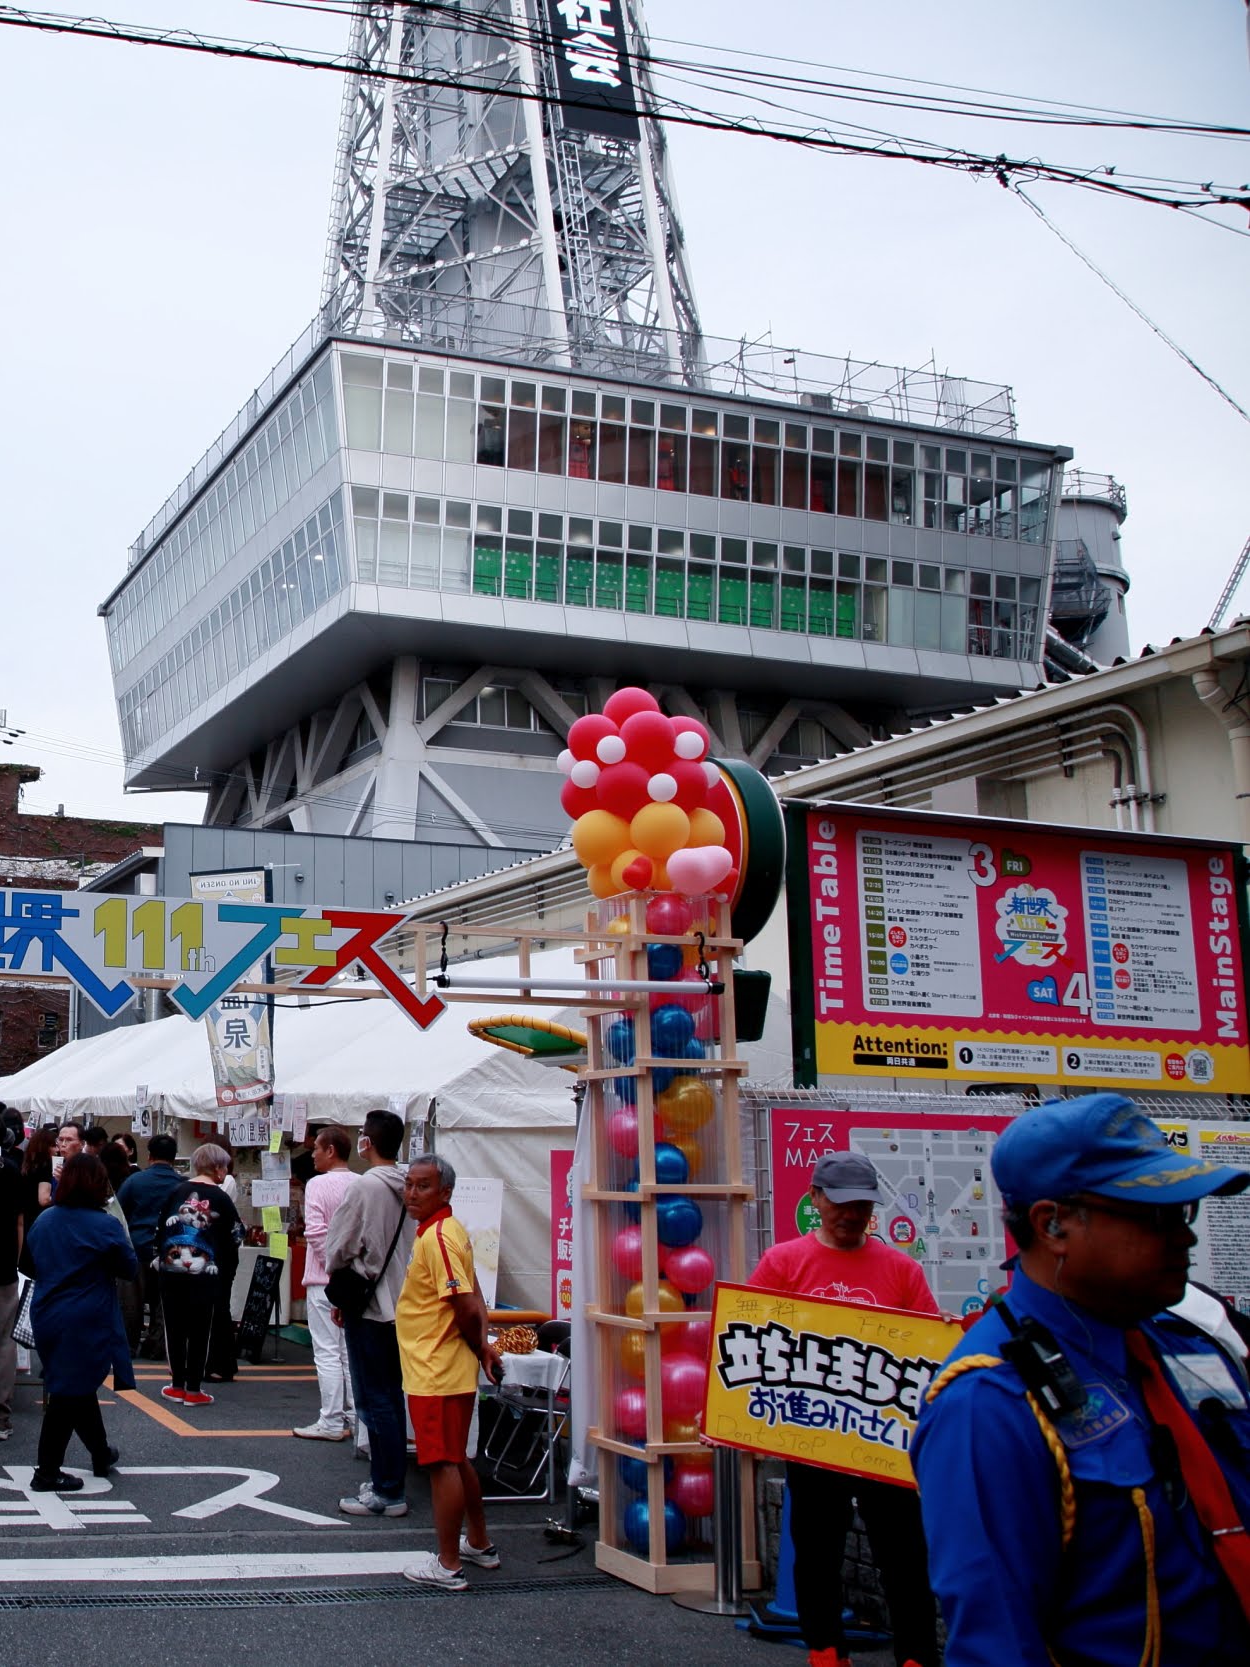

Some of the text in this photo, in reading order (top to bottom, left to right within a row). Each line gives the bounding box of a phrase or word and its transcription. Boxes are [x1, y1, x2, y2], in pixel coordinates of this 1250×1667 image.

[968, 843, 997, 887] 3
[1006, 860, 1023, 872] FRI
[812, 820, 845, 1014] TimeTable
[1005, 892, 1058, 919] 新世界
[994, 939, 1074, 968] フェス
[1208, 856, 1240, 1039] MainStage
[93, 897, 216, 972] 111th
[174, 904, 447, 1030] フェス
[1033, 987, 1053, 998] SAT
[1063, 972, 1093, 1016] 4
[853, 1034, 948, 1055] Attention:
[886, 1056, 916, 1067] 両日共通
[230, 1124, 269, 1144] 犬の温泉
[784, 1122, 835, 1143] フェス
[908, 1193, 918, 1209] D
[558, 1218, 574, 1237] チ
[916, 1237, 926, 1253] A
[856, 1316, 913, 1342] Free
[749, 1387, 909, 1449] お進み下さい
[850, 1447, 898, 1472] Come
